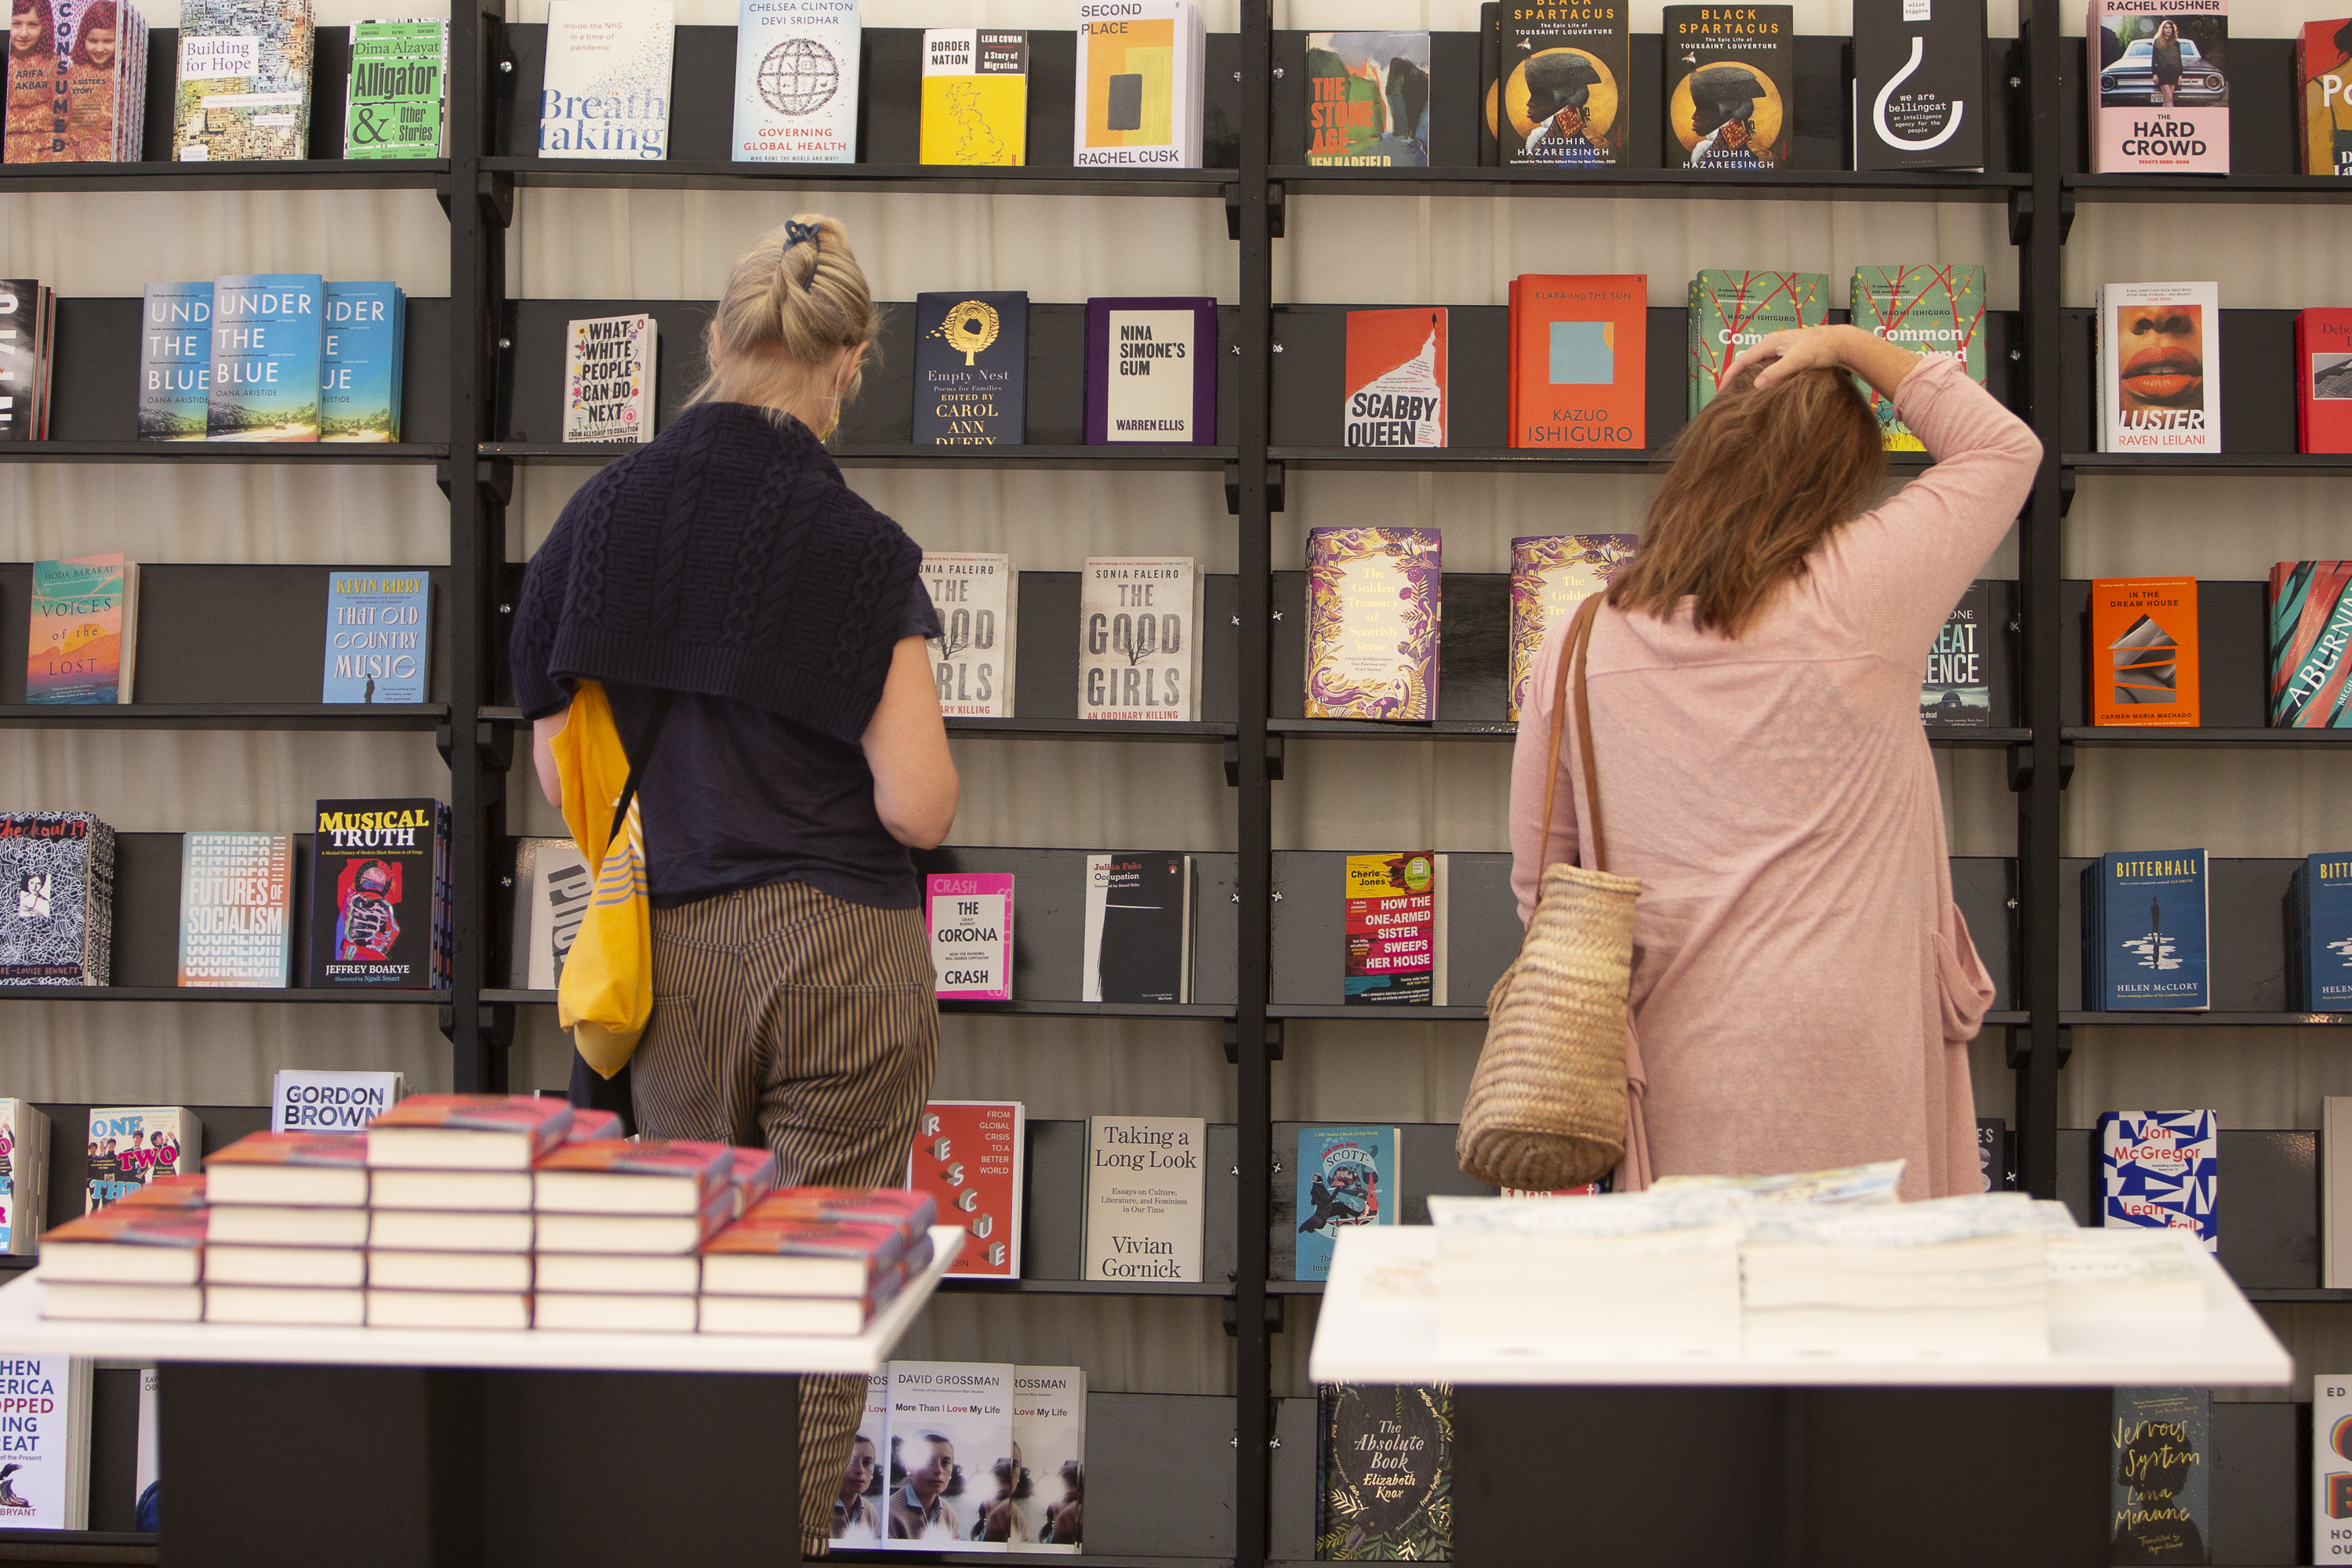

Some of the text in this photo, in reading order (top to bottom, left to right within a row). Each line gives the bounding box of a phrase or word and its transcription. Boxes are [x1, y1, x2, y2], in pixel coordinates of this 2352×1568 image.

[1081, 4, 1142, 16] SECOND
[2107, 1, 2220, 10] RACHEL KUSHNER
[1514, 9, 1614, 20] SPARTACUS
[1081, 22, 1128, 34] PLACE
[187, 41, 249, 57] Building
[931, 42, 970, 52] BORDER
[186, 58, 251, 74] for Hope
[931, 55, 968, 65] NATION
[354, 62, 437, 100] Alligator
[541, 87, 666, 120] Breath
[1889, 103, 1947, 112] bellingcat
[400, 107, 426, 123] Other
[398, 125, 433, 141] Stories
[2133, 122, 2195, 137] HARD
[539, 119, 663, 158] taking
[798, 142, 847, 151] HEALTH
[2122, 140, 2207, 155] CROWD
[1079, 151, 1179, 165] RACHEL CUSK
[221, 293, 311, 314] UNDER
[589, 321, 630, 339] WHAT
[1120, 325, 1152, 340] NINA
[219, 328, 265, 349] THE
[586, 340, 632, 360] WHITE
[1120, 343, 1185, 358] SIMONE'S
[217, 362, 278, 383] BLUE
[583, 361, 633, 380] PEOPLE
[928, 370, 1009, 383] Empty Nest
[1120, 361, 1150, 376] GUM
[583, 381, 630, 401] CAN DO
[589, 403, 624, 423] NEXT
[1352, 393, 1438, 421] SCABBY
[1553, 410, 1608, 422] KAZUO
[2119, 409, 2205, 430] LUSTER
[1348, 421, 1416, 447] QUEEN
[1529, 426, 1632, 442] ISHIGURO
[2118, 435, 2205, 446] RAVEN LEILANI
[1096, 570, 1128, 579] SONIA
[1363, 568, 1385, 579] The
[336, 579, 422, 593] KEVIN BARRY
[1352, 583, 1395, 593] Golden
[1118, 584, 1154, 607] THE
[1347, 597, 1399, 610] Treasury
[42, 597, 111, 618] VOICES
[336, 607, 419, 625] THAT OLD
[1088, 613, 1181, 655] GOOD
[1348, 626, 1397, 637] Scottish
[333, 632, 419, 649] COUNTRY
[1356, 641, 1387, 652] Verse
[49, 659, 96, 676] LOST
[334, 655, 417, 679] MUSIC
[1087, 668, 1180, 706] GIRLS
[1101, 711, 1143, 720] ORDINARY
[330, 828, 415, 847] TRUTH
[1351, 869, 1380, 878] Cherie
[2116, 859, 2197, 877] BITTERHALL
[1094, 873, 1139, 881] Occupation
[1359, 877, 1385, 886] Jones
[190, 877, 283, 906] FUTURES OF
[957, 902, 978, 915] THE
[1381, 898, 1407, 909] HOW
[1410, 896, 1431, 907] THE
[187, 906, 282, 935] SOCIALISM
[1365, 910, 1431, 925] ONE-ARMED
[938, 927, 998, 942] CORONA
[1377, 926, 1418, 939] SISTER
[1384, 940, 1428, 953] SWEEPS
[1366, 953, 1430, 969] HER HOUSE
[325, 965, 410, 975] JEFFREY BOAKYE
[945, 970, 988, 985] CRASH
[2154, 982, 2198, 991] McCLORY
[286, 1085, 383, 1105] GORDON
[1104, 1126, 1189, 1149] Taking a
[1094, 1149, 1197, 1171] Long Look
[1326, 1149, 1370, 1167] SCOTT-
[2114, 1145, 2201, 1163] McGregor
[1112, 1236, 1174, 1254] Vivian
[1102, 1258, 1181, 1278] Gornick
[898, 1374, 1000, 1386] DAVID GROSSMAN
[896, 1403, 916, 1412] More
[947, 1404, 967, 1413] Love
[970, 1405, 982, 1414] My
[985, 1406, 1000, 1414] Life
[1379, 1421, 1402, 1433] The
[1354, 1434, 1425, 1451] Absolute
[1370, 1452, 1414, 1474] Book
[2125, 1444, 2200, 1480] System
[1363, 1473, 1416, 1486] Elizabeth
[1376, 1486, 1403, 1503] Knox
[2127, 1484, 2172, 1505] Lina
[2114, 1507, 2190, 1531] Meruane
